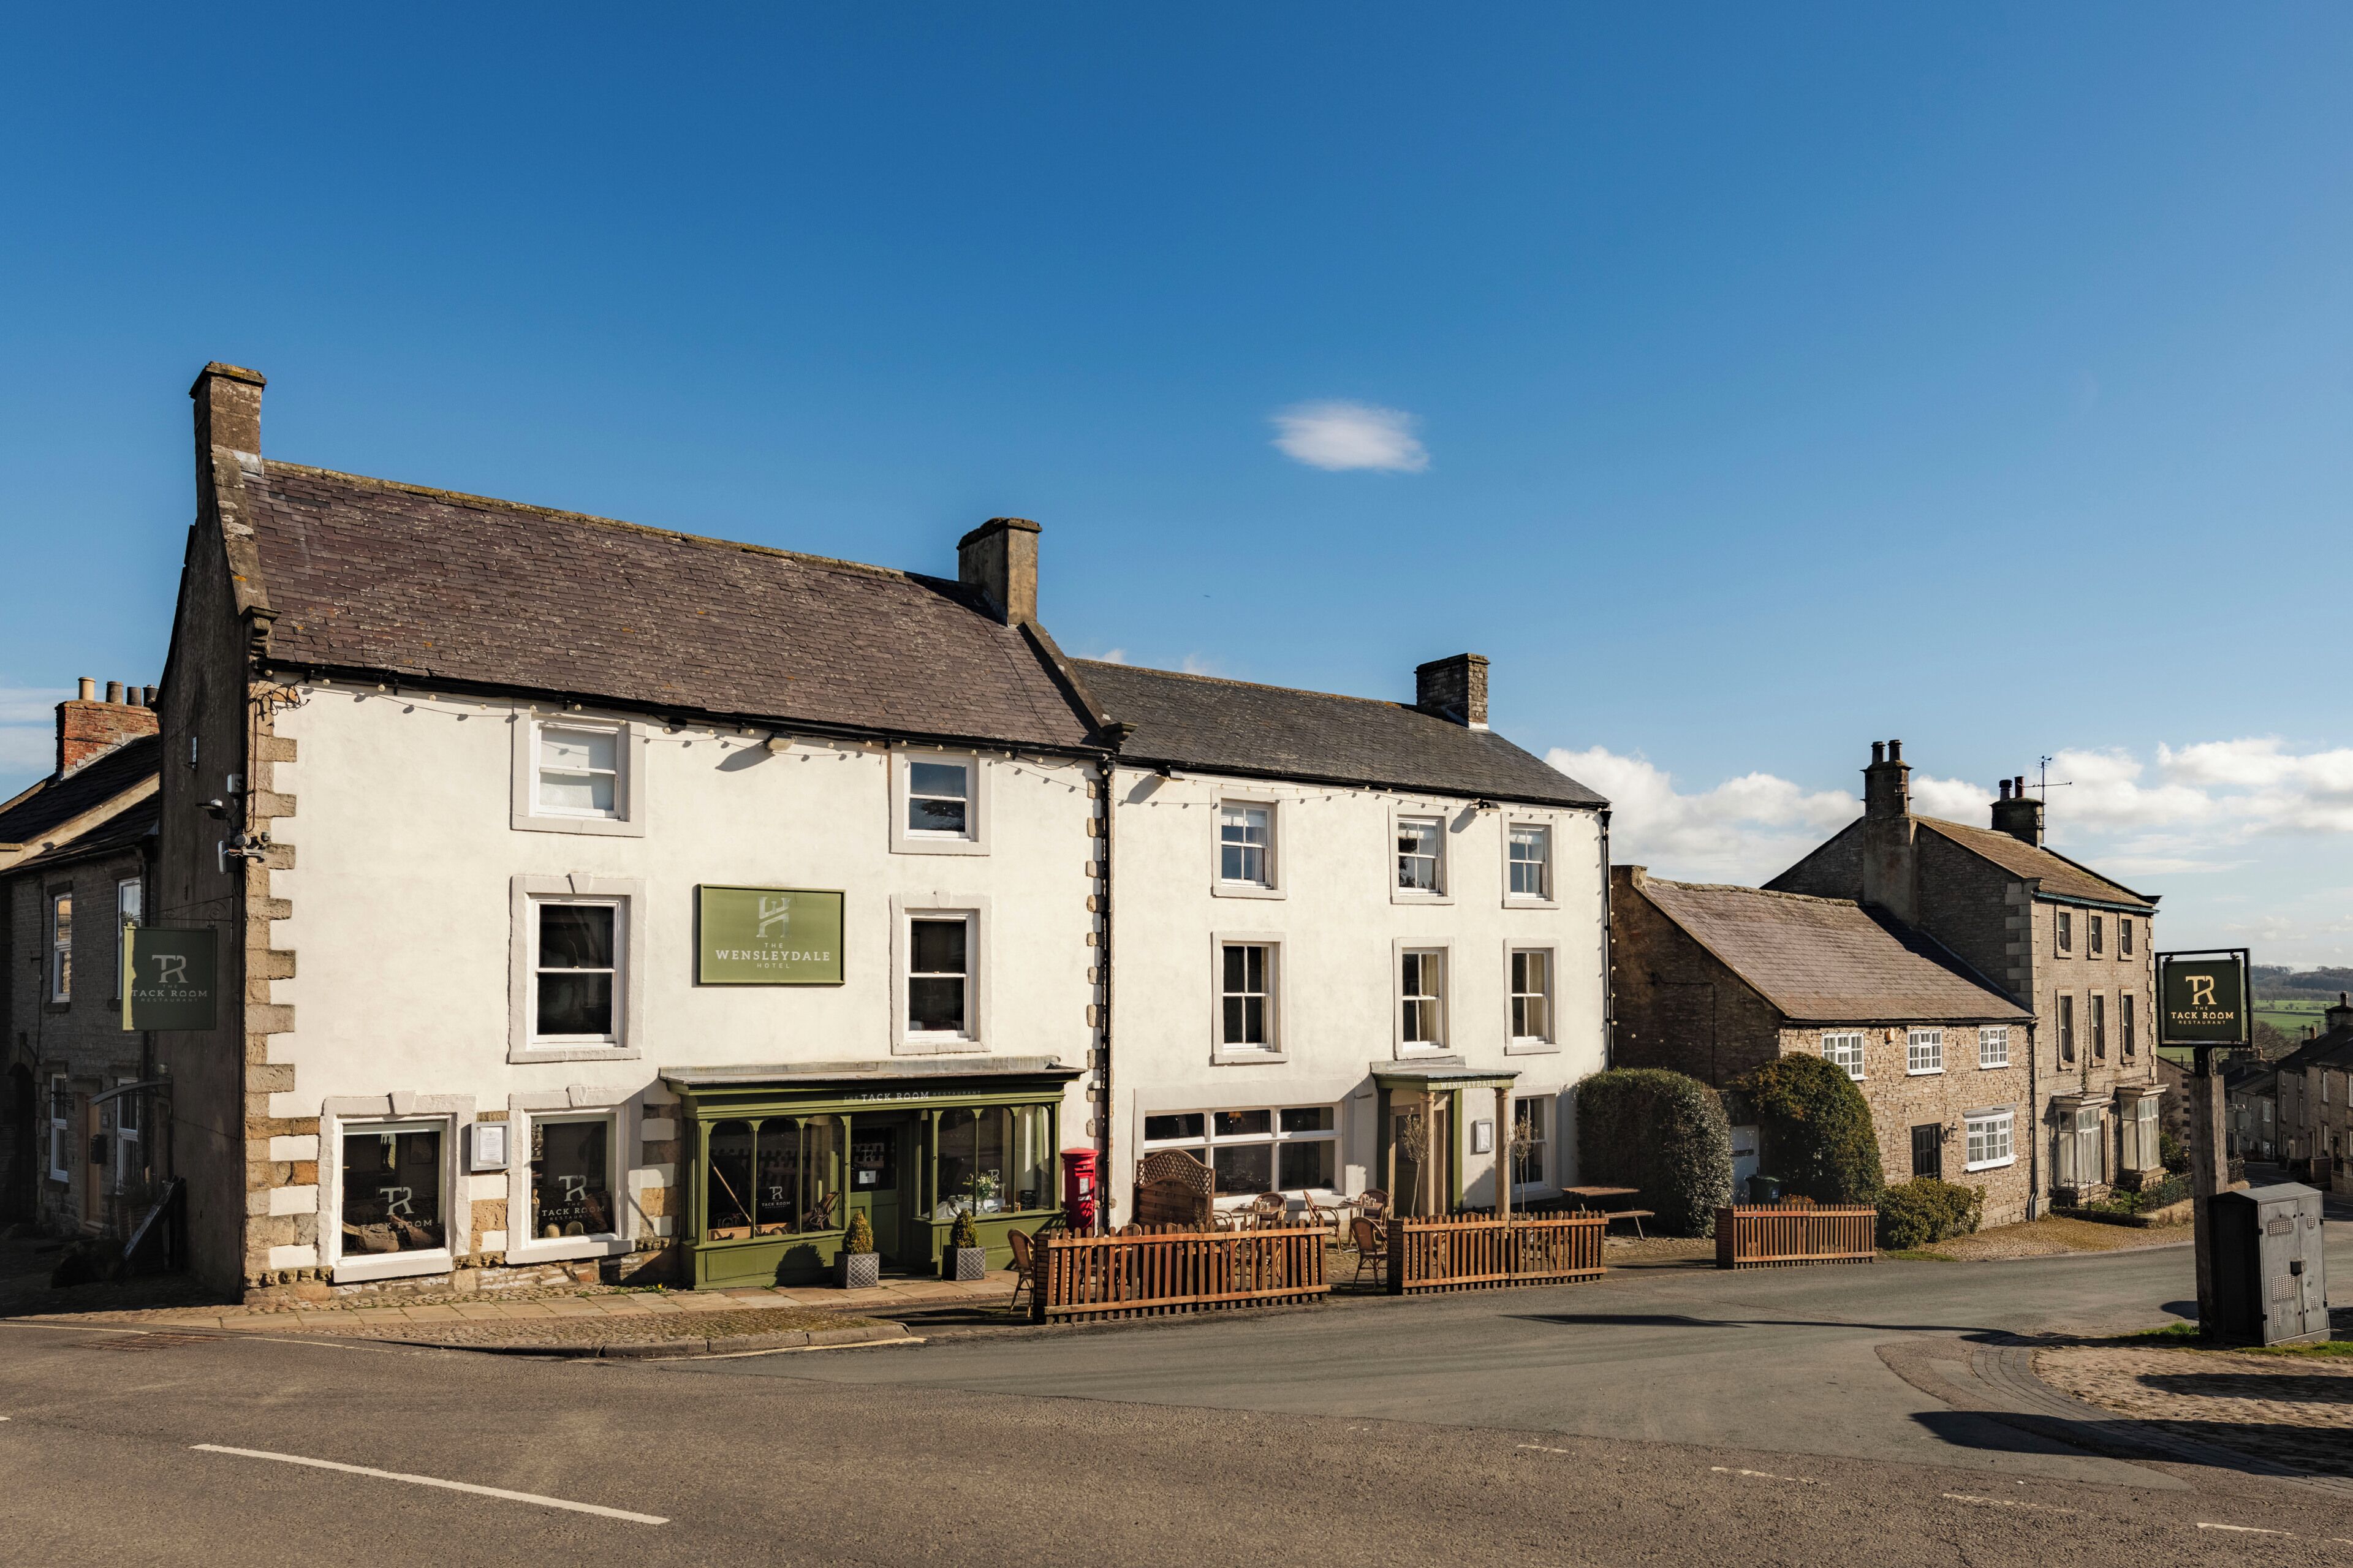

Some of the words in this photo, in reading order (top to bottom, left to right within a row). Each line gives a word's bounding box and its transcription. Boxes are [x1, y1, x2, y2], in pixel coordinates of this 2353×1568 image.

[716, 950, 830, 961] WENSLEYDALE
[862, 1093, 891, 1102] TACK
[896, 1091, 929, 1100] ROOM
[575, 1205, 605, 1214] ROOM
[360, 1222, 392, 1231] TACK
[398, 1219, 432, 1229] ROOM
